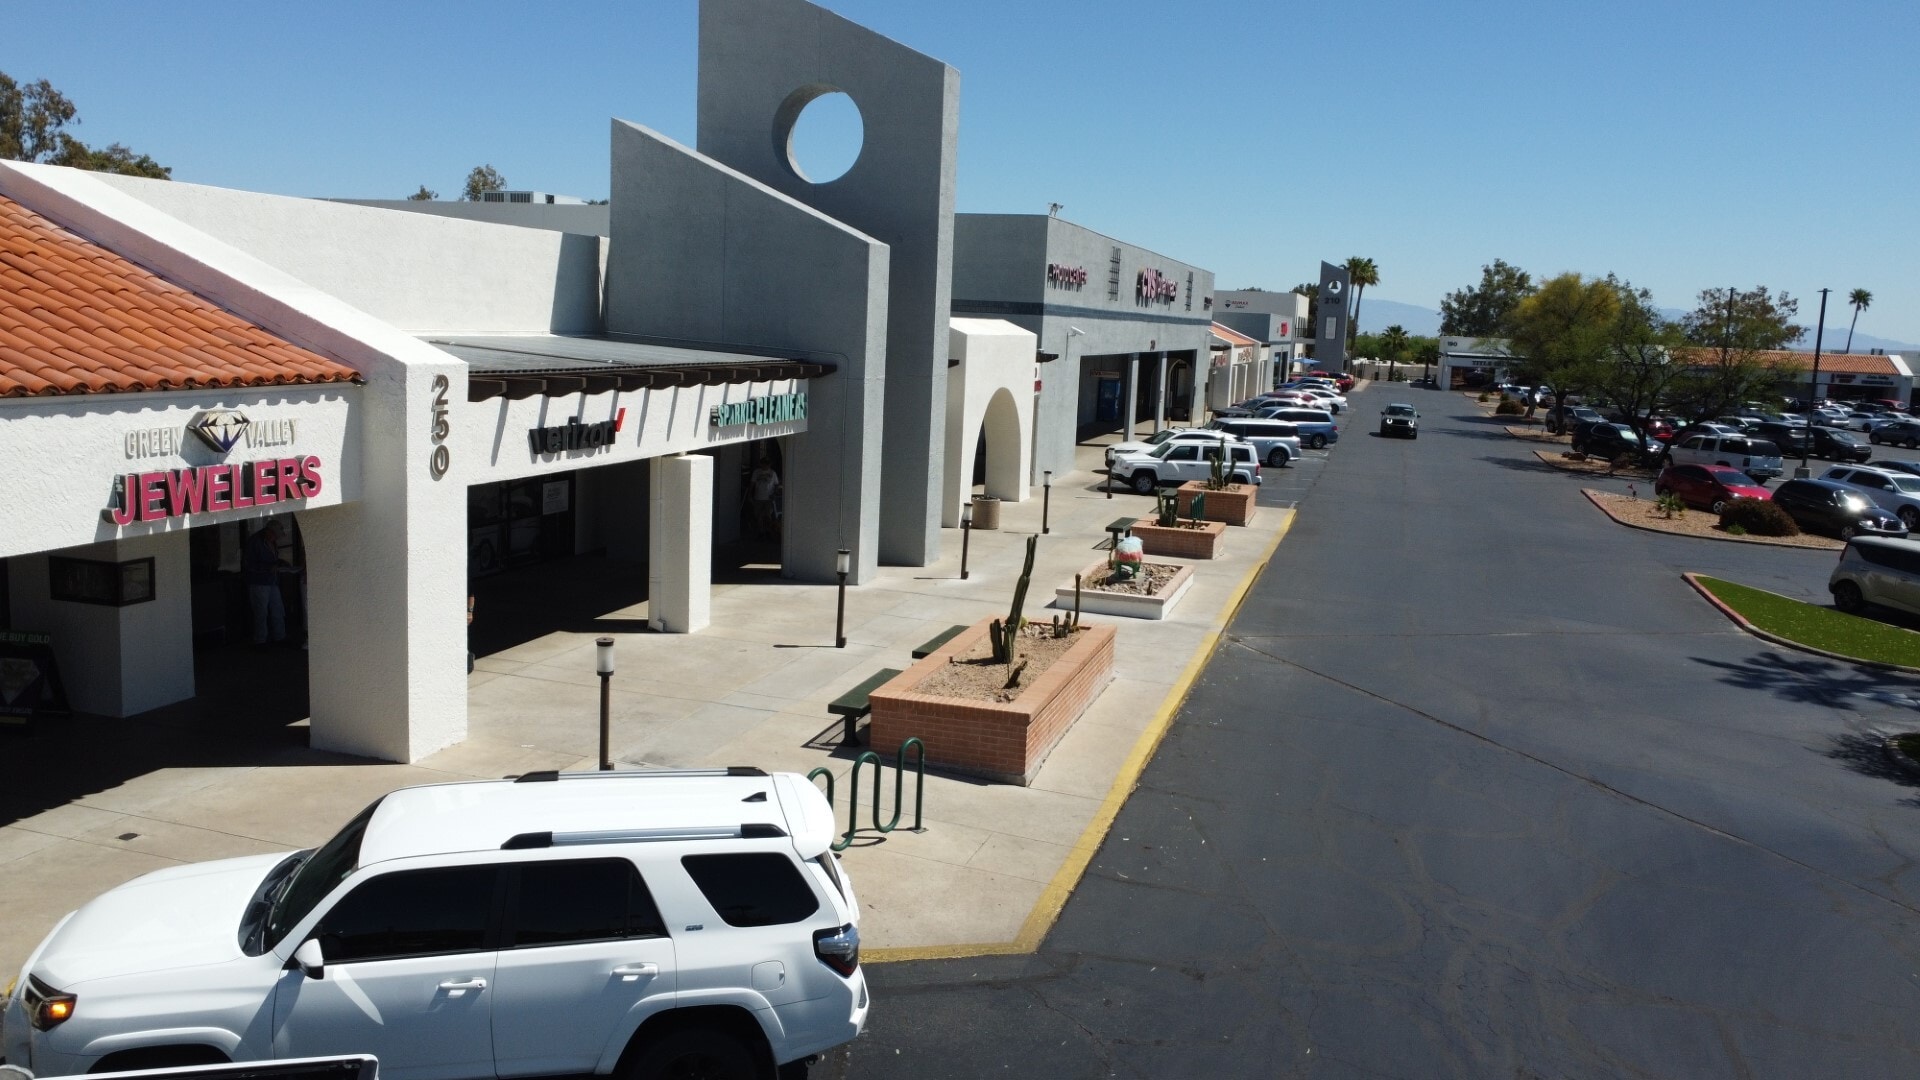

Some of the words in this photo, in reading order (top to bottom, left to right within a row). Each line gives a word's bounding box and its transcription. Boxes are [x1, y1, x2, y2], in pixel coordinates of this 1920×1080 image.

[432, 374, 450, 476] 250
[717, 401, 755, 428] SPARKLE
[756, 393, 806, 426] CLEANERS
[125, 427, 181, 459] GREEN
[246, 418, 298, 448] VALLEY
[529, 416, 616, 454] verizon
[109, 454, 322, 526] JEWELERS
[9, 632, 27, 641] BUY
